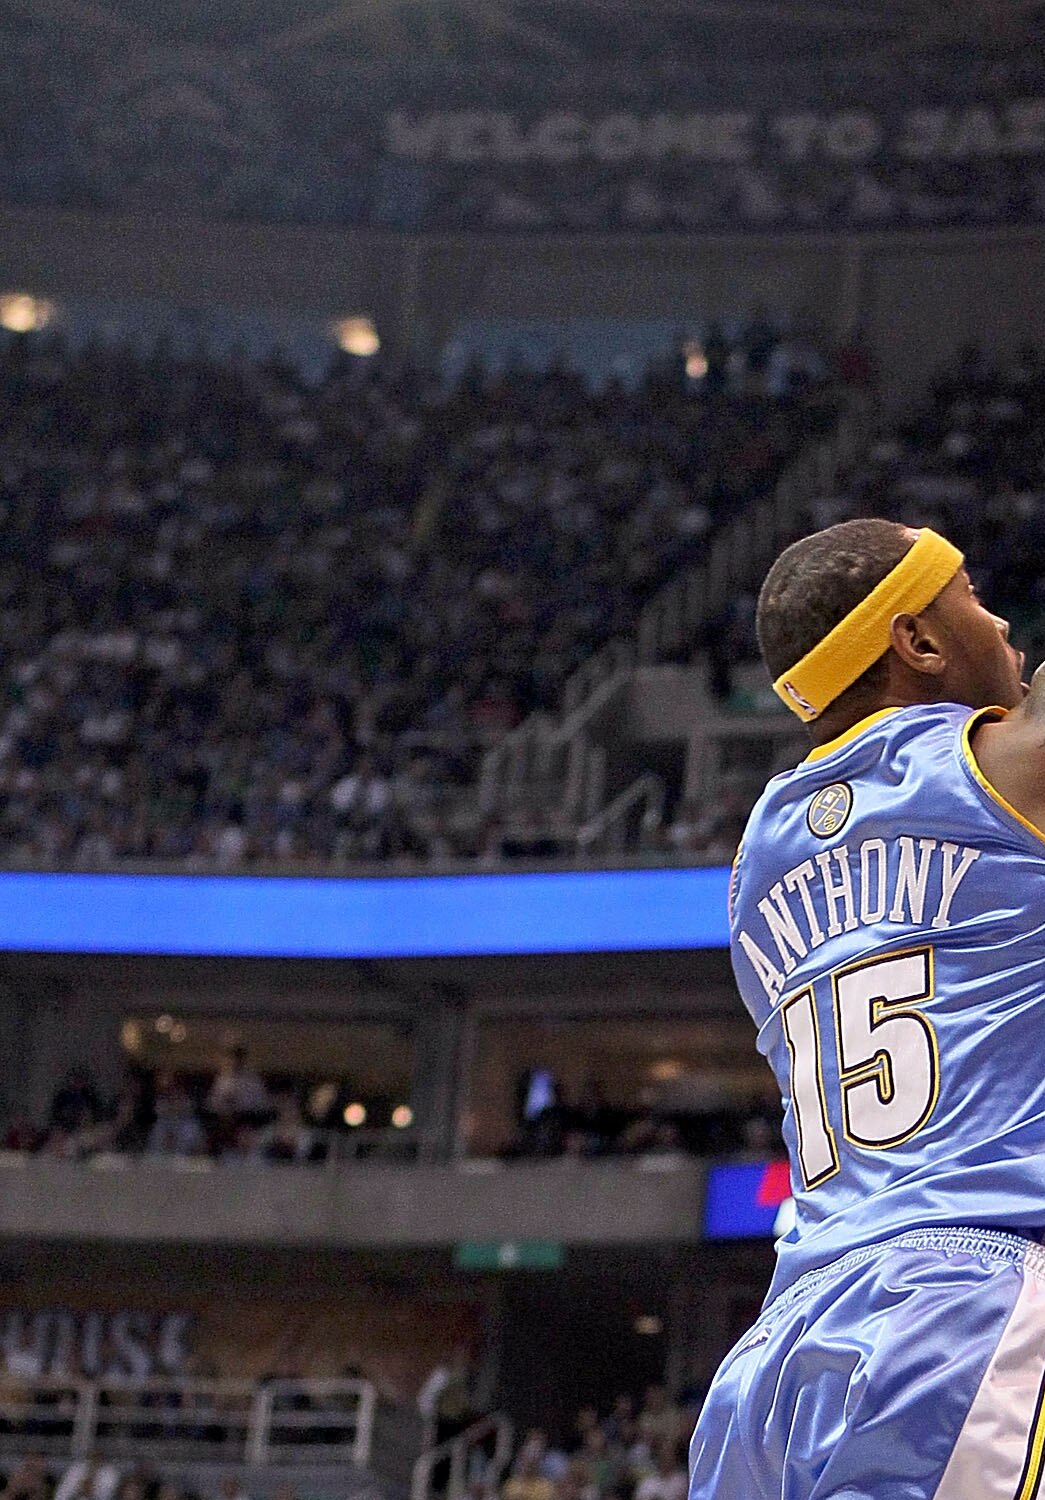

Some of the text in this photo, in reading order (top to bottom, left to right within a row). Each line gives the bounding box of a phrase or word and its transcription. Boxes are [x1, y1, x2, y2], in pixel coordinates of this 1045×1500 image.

[386, 111, 756, 163] WELCOME
[772, 111, 885, 160] TO
[737, 835, 981, 1005] ANTHONY
[780, 944, 941, 1192] 15
